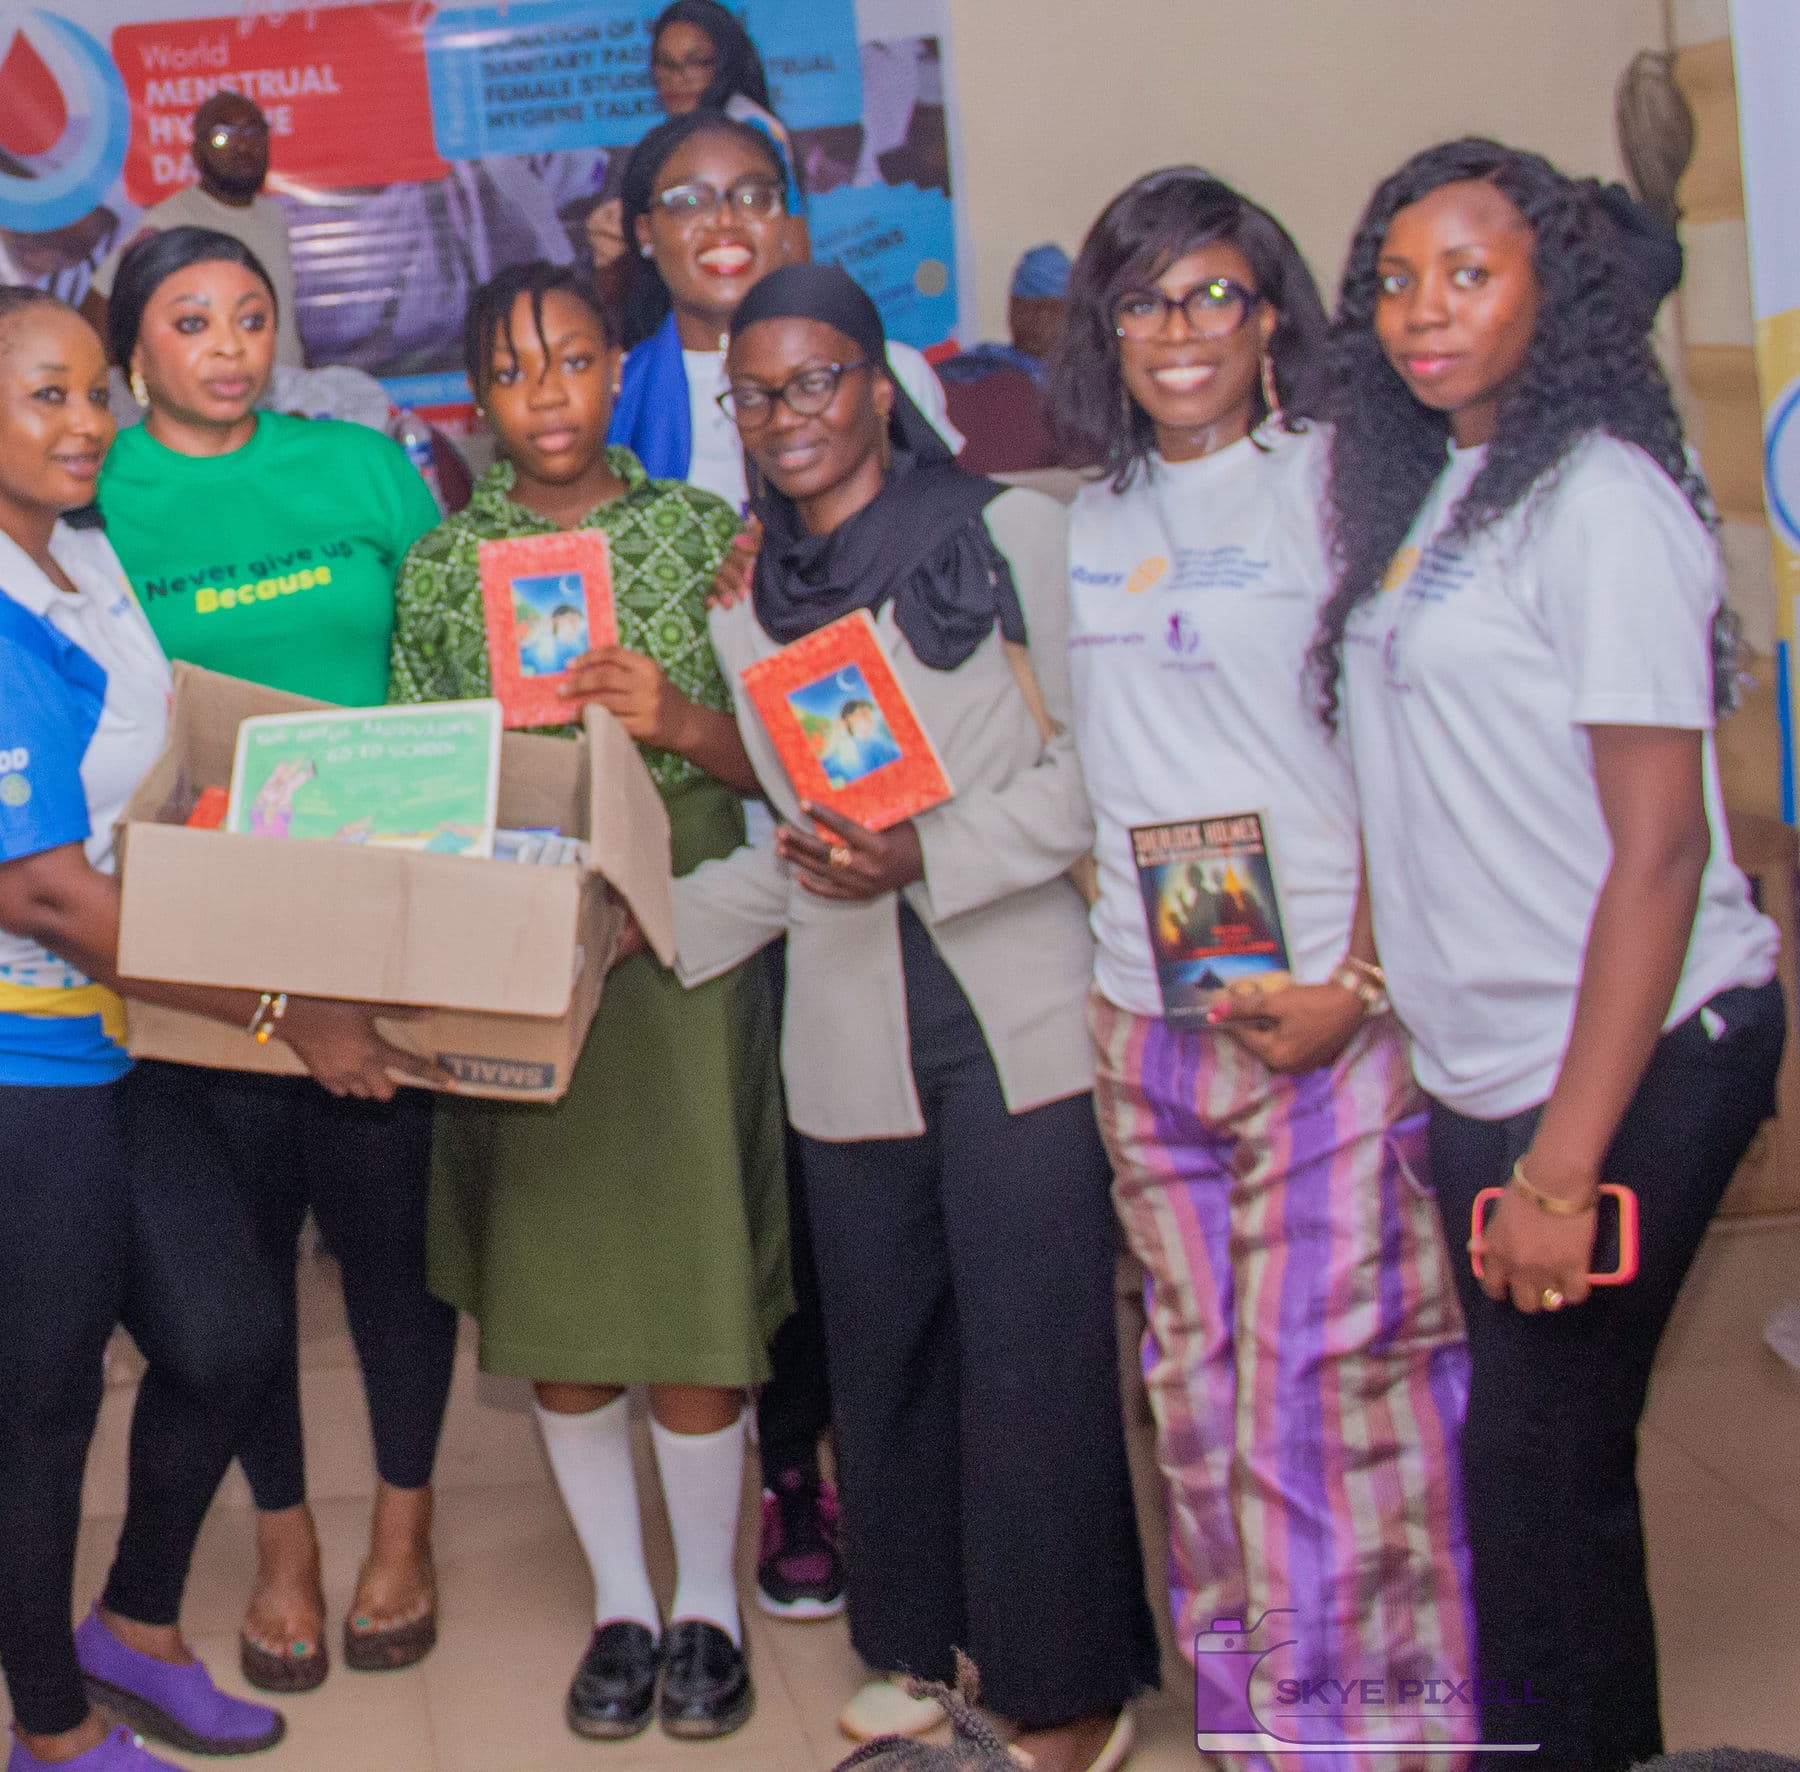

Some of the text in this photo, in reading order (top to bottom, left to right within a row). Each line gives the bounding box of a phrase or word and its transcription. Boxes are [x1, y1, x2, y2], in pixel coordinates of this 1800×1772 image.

[139, 34, 230, 70] World
[146, 65, 341, 107] MENSTRUAL
[485, 78, 573, 102] FEMALE
[152, 150, 200, 187] DA
[146, 562, 237, 599] Never
[248, 546, 313, 578] give
[195, 566, 332, 614] Because
